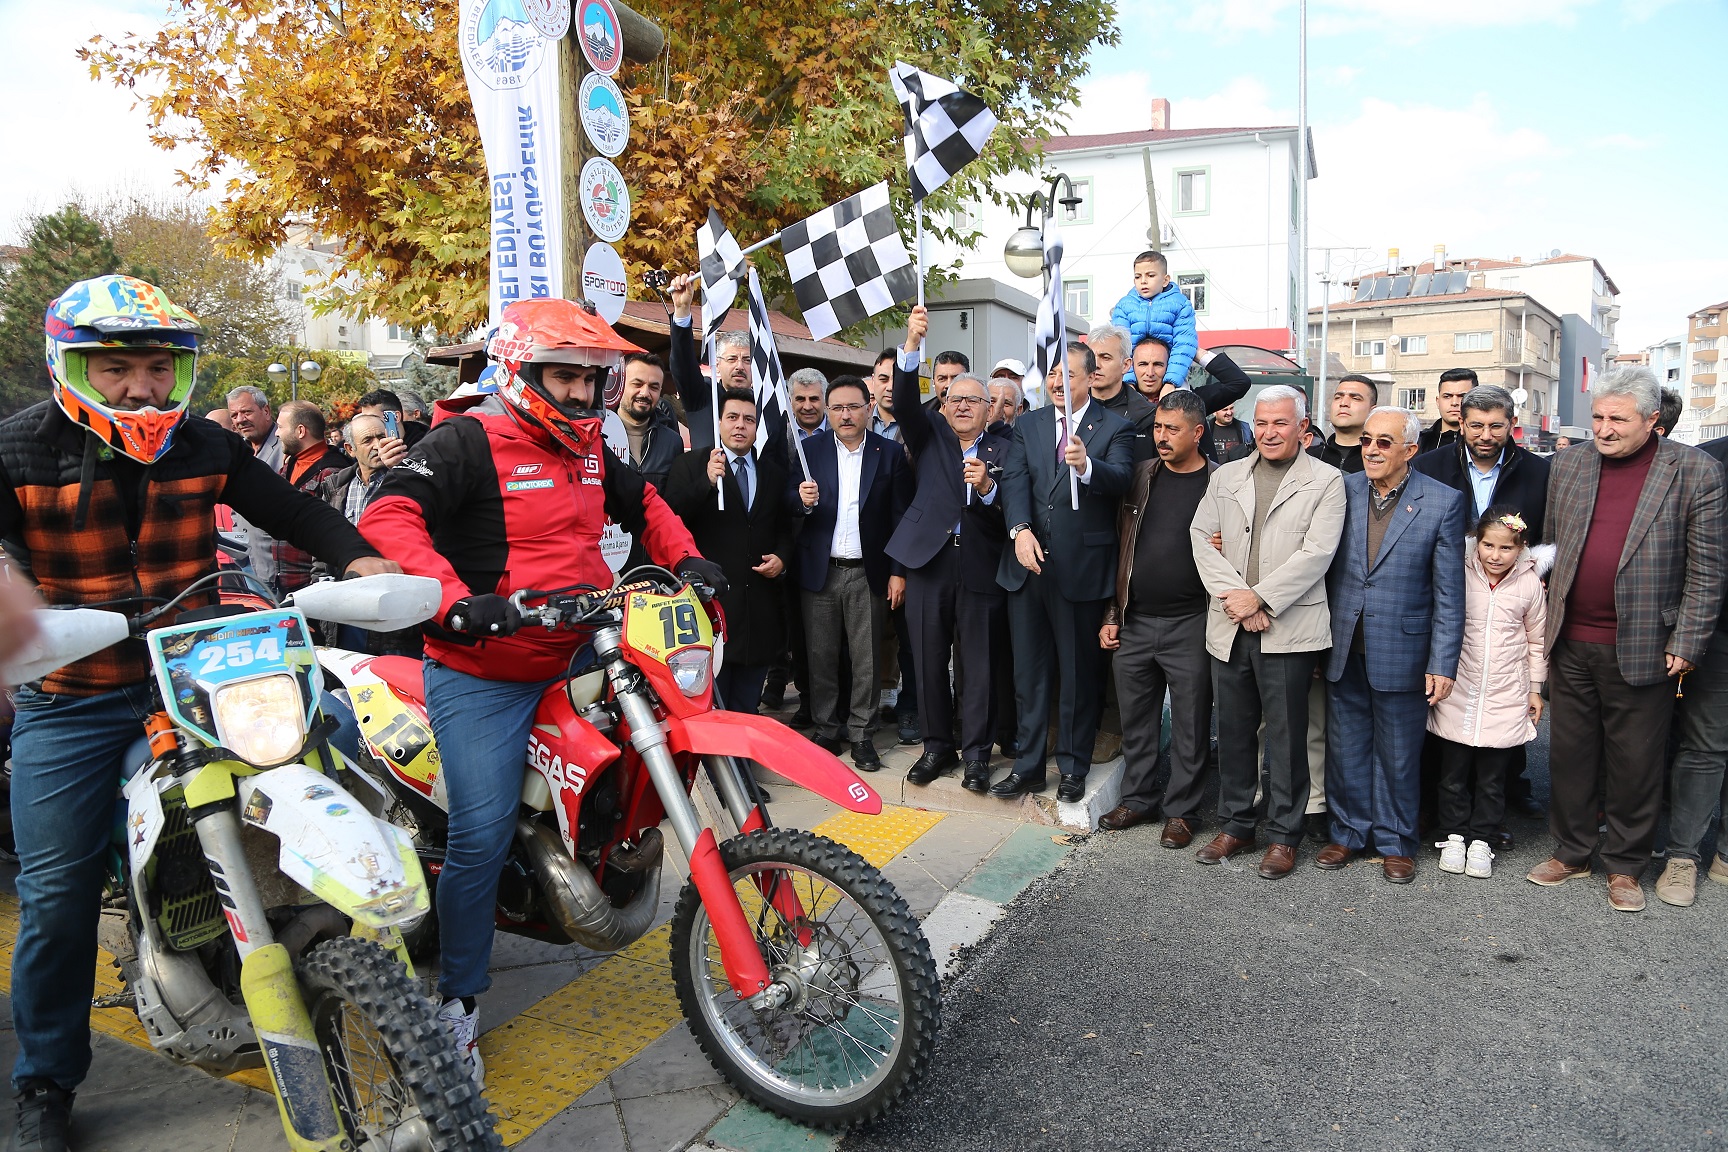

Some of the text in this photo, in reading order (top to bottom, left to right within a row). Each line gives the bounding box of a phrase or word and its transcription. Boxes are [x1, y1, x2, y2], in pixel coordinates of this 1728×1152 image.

[492, 338, 534, 361] 100%
[659, 603, 701, 650] 19
[198, 637, 282, 676] 254
[369, 712, 432, 767] 19
[525, 733, 587, 796] SGAS
